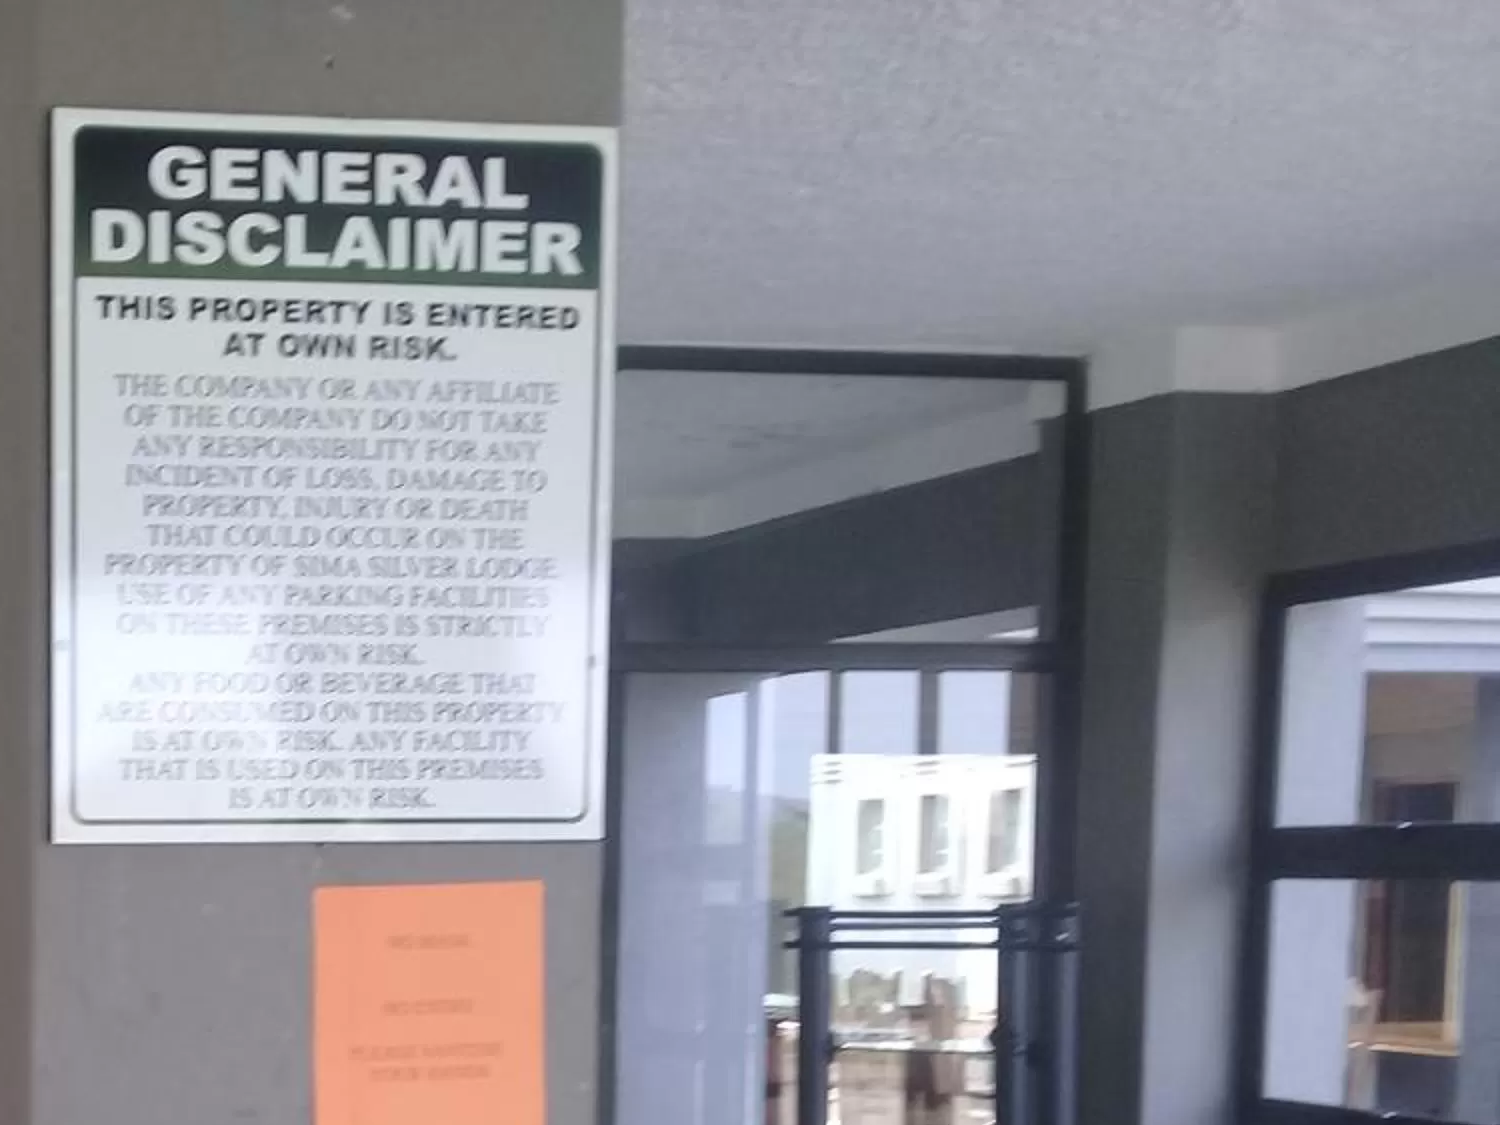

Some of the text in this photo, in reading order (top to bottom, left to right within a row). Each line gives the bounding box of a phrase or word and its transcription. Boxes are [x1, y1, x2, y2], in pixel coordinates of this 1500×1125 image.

[147, 145, 530, 210] GENERAL
[91, 207, 584, 276] DISCLAIMER
[95, 295, 580, 329] THIS PROPERTY IS ENTERED
[221, 332, 458, 361] AT OWN RISK.
[112, 373, 561, 404] THE COMPANY OR ANY AFFILIATE
[123, 403, 548, 434] OF THE COMPANY DO NOT TAKE
[132, 434, 543, 463] ANY RESPONSIBILITY FOR ANY
[124, 463, 260, 488] INCIDENT
[262, 465, 298, 489] OF
[387, 467, 506, 492] DAMAGE
[511, 469, 548, 493] TO
[294, 495, 389, 519] INJURY
[395, 497, 433, 520] OR
[440, 498, 529, 521] DEATH
[144, 523, 524, 550] THAT COULD OCCUR ON THE
[104, 553, 247, 576] PROPERTY
[250, 554, 288, 577] OF
[367, 556, 459, 579] SILVER
[116, 583, 172, 606] USE
[177, 583, 212, 606] OF
[284, 584, 404, 608] PARKING
[409, 586, 549, 609] FACILITIES
[163, 612, 252, 636] THESE
[259, 613, 388, 637] PREMISES
[395, 614, 421, 638] IS
[424, 614, 551, 638] STRICTLY
[193, 671, 269, 695] FOOD
[275, 672, 315, 695] OR
[320, 671, 466, 695] BEVERAGE
[468, 672, 536, 695] THAT
[319, 700, 360, 723] ON
[366, 701, 427, 724] THIS
[432, 701, 567, 724] PROPERTY
[160, 729, 196, 752] AT
[412, 730, 533, 753] FACILITY
[118, 757, 545, 781] THAT IS USED ON THIS PREMISES
[256, 786, 293, 809] AT
